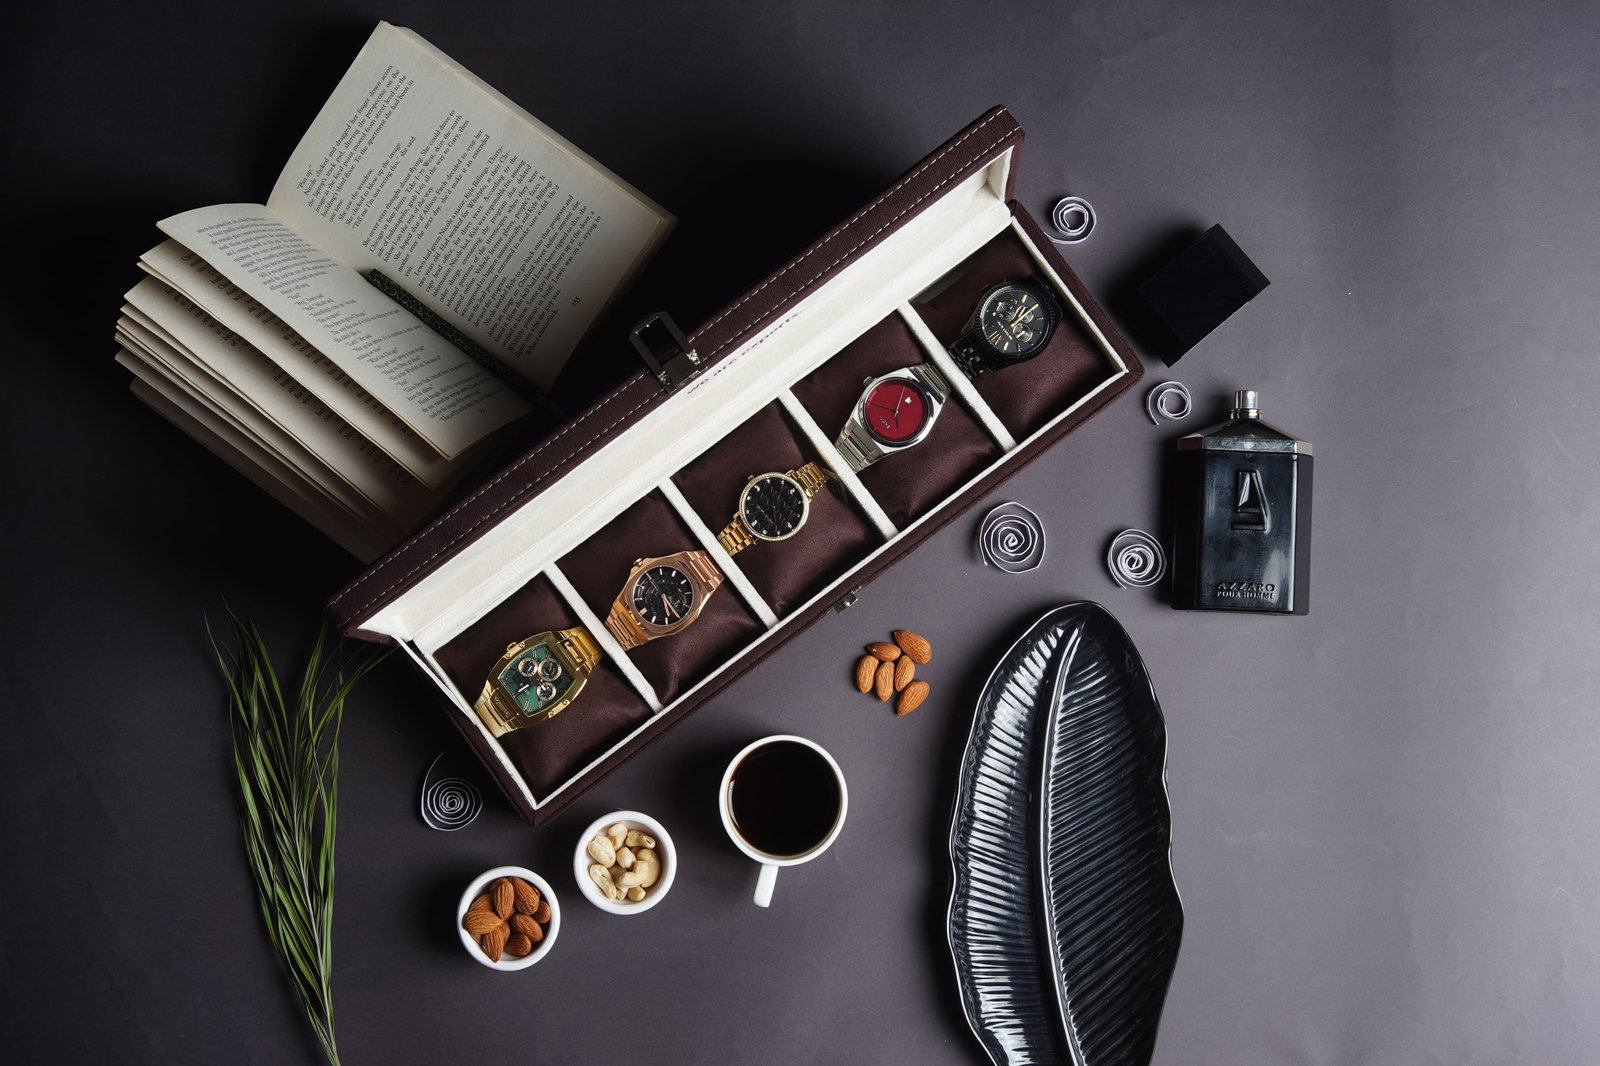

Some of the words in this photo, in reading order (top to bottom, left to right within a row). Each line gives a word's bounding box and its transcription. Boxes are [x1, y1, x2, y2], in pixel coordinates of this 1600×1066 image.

[303, 177, 317, 196] Nicole
[315, 156, 330, 178] clicked
[327, 145, 337, 158] and
[335, 123, 352, 147] dragged
[348, 113, 359, 125] her
[356, 97, 371, 115] finger
[368, 80, 382, 97] down
[380, 64, 394, 81] across
[325, 162, 337, 177] track
[343, 128, 361, 150] altering
[357, 118, 367, 128] the
[364, 88, 387, 119] perspective
[385, 79, 393, 88] on
[391, 68, 400, 80] the
[327, 179, 336, 190] the
[332, 164, 345, 180] focal
[342, 151, 355, 167] point
[352, 131, 367, 152] moved
[364, 119, 377, 134] from
[374, 103, 387, 120] street
[383, 89, 396, 105] level
[393, 83, 401, 91] to
[398, 74, 408, 85] the
[335, 176, 347, 193] third
[353, 154, 362, 163] To
[359, 145, 369, 156] the
[366, 118, 387, 147] apartment
[384, 109, 393, 120] she
[389, 98, 401, 111] had
[396, 85, 410, 100] been
[407, 79, 415, 87] in
[434, 139, 445, 153] skirt
[442, 129, 452, 140] the
[449, 114, 463, 131] north
[344, 215, 354, 226] She
[351, 195, 366, 216] clicked
[362, 189, 370, 197] to
[366, 175, 378, 191] blow
[376, 168, 384, 177] up
[381, 158, 391, 169] the
[361, 236, 371, 248] She
[368, 221, 380, 238] never
[377, 209, 388, 223] even
[385, 187, 402, 210] thought
[399, 172, 412, 189] about
[420, 145, 431, 157] She
[428, 128, 441, 146] could
[438, 115, 451, 131] drive
[448, 109, 456, 117] to
[382, 238, 389, 247] of
[407, 194, 418, 209] grab
[428, 165, 438, 176] the
[435, 153, 446, 166] way
[443, 147, 450, 155] to
[458, 119, 470, 133] then
[385, 211, 396, 224] four
[392, 250, 402, 262] She
[398, 231, 413, 251] hoped
[410, 220, 421, 233] that
[417, 214, 425, 222] if
[422, 195, 438, 216] Allison
[434, 180, 448, 195] Fitch
[445, 158, 463, 181] decided
[460, 152, 468, 160] to
[465, 139, 477, 152] visit
[473, 128, 483, 140] her
[404, 180, 417, 194] Take
[448, 249, 464, 268] Nicole
[467, 225, 480, 239] Kyle
[477, 215, 487, 226] was
[484, 187, 506, 217] responsible
[510, 159, 526, 179] among
[368, 230, 385, 253] Chicago
[382, 223, 389, 231] in
[413, 260, 427, 277] Lewis
[422, 248, 433, 261] had
[429, 235, 442, 252] given
[438, 217, 454, 237] Nicole
[463, 186, 475, 200] Kyle
[417, 276, 427, 288] two
[424, 262, 435, 277] years
[438, 237, 450, 251] Had
[447, 217, 464, 238] worked
[460, 209, 470, 219] for
[486, 176, 492, 184] at
[490, 163, 501, 177] their
[1216, 590, 1241, 598] POUR
[1243, 591, 1274, 600] HOMME
[1217, 582, 1276, 592] AZZARO
